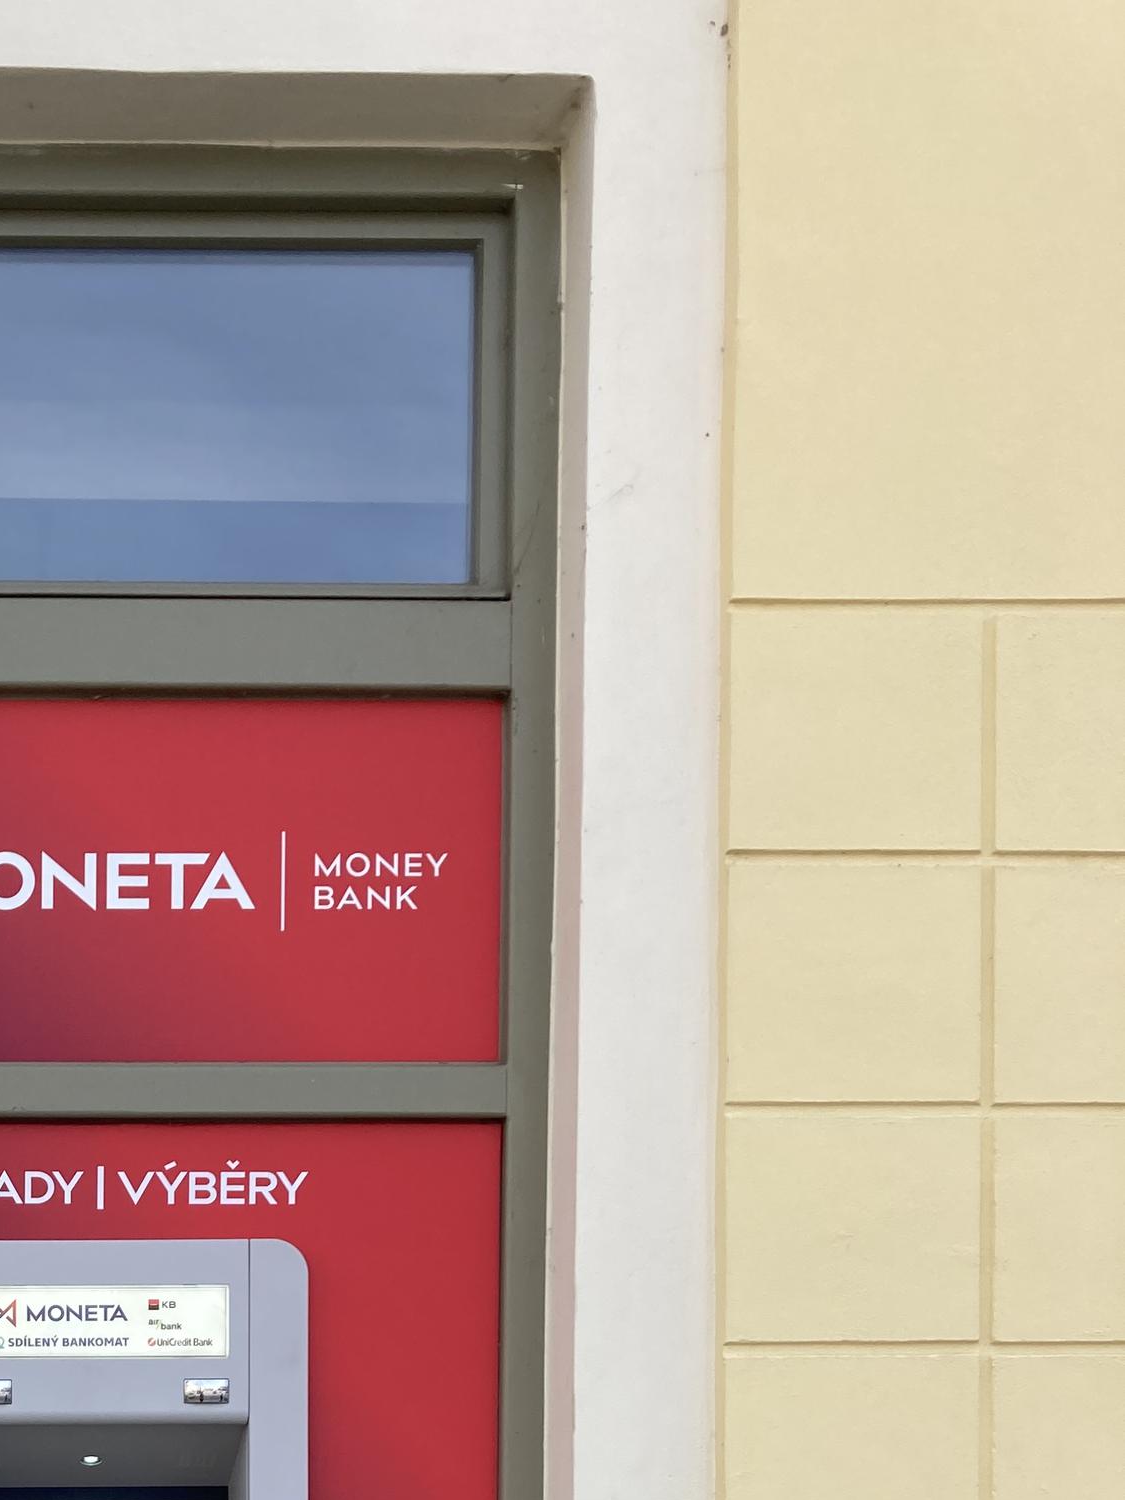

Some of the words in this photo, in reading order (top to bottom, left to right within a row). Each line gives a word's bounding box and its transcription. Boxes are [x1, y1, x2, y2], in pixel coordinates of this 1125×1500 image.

[314, 851, 448, 878] MONEY
[314, 885, 418, 911] BANK
[117, 1159, 309, 1206] VÝBĚRY
[161, 1300, 177, 1309] KB
[26, 1304, 128, 1323] MONETA
[160, 1322, 182, 1330] bank
[8, 1334, 58, 1348] SDÍLENÝ
[62, 1337, 130, 1348] BANKOMAT
[156, 1337, 192, 1347] UniCredit
[193, 1337, 214, 1347] Bank
